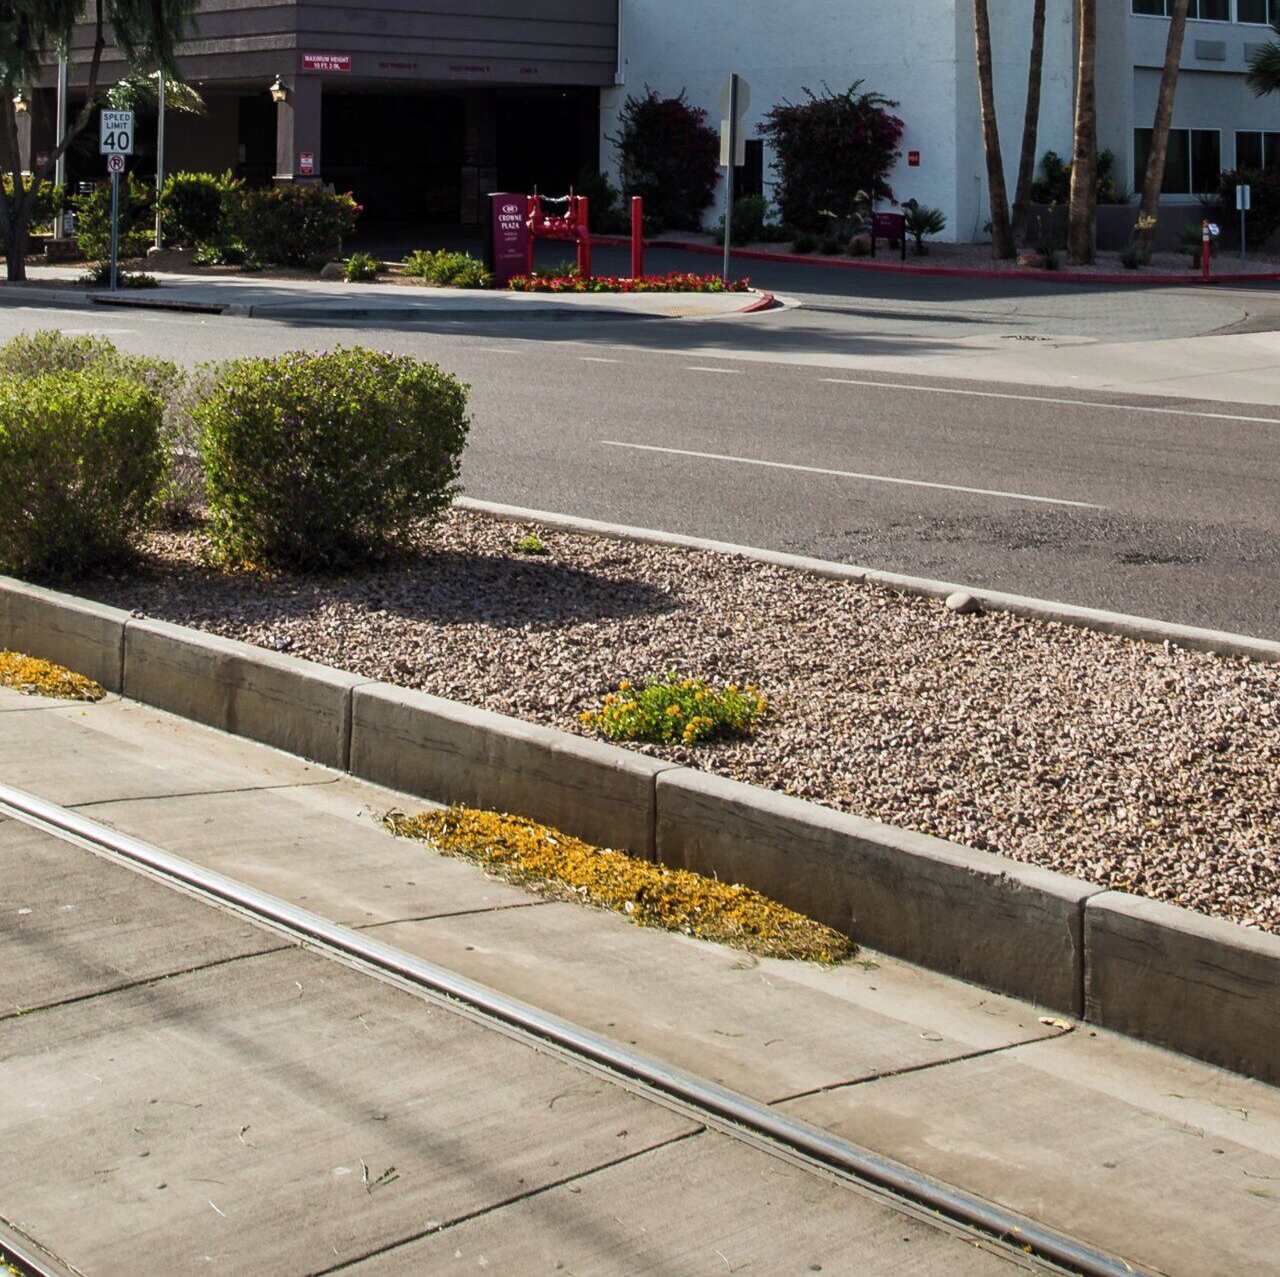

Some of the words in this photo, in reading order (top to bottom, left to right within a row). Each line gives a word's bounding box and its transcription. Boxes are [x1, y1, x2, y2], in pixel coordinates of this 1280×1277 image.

[103, 113, 130, 121] SPEED
[103, 131, 130, 150] 40
[498, 214, 522, 222] CROWNE
